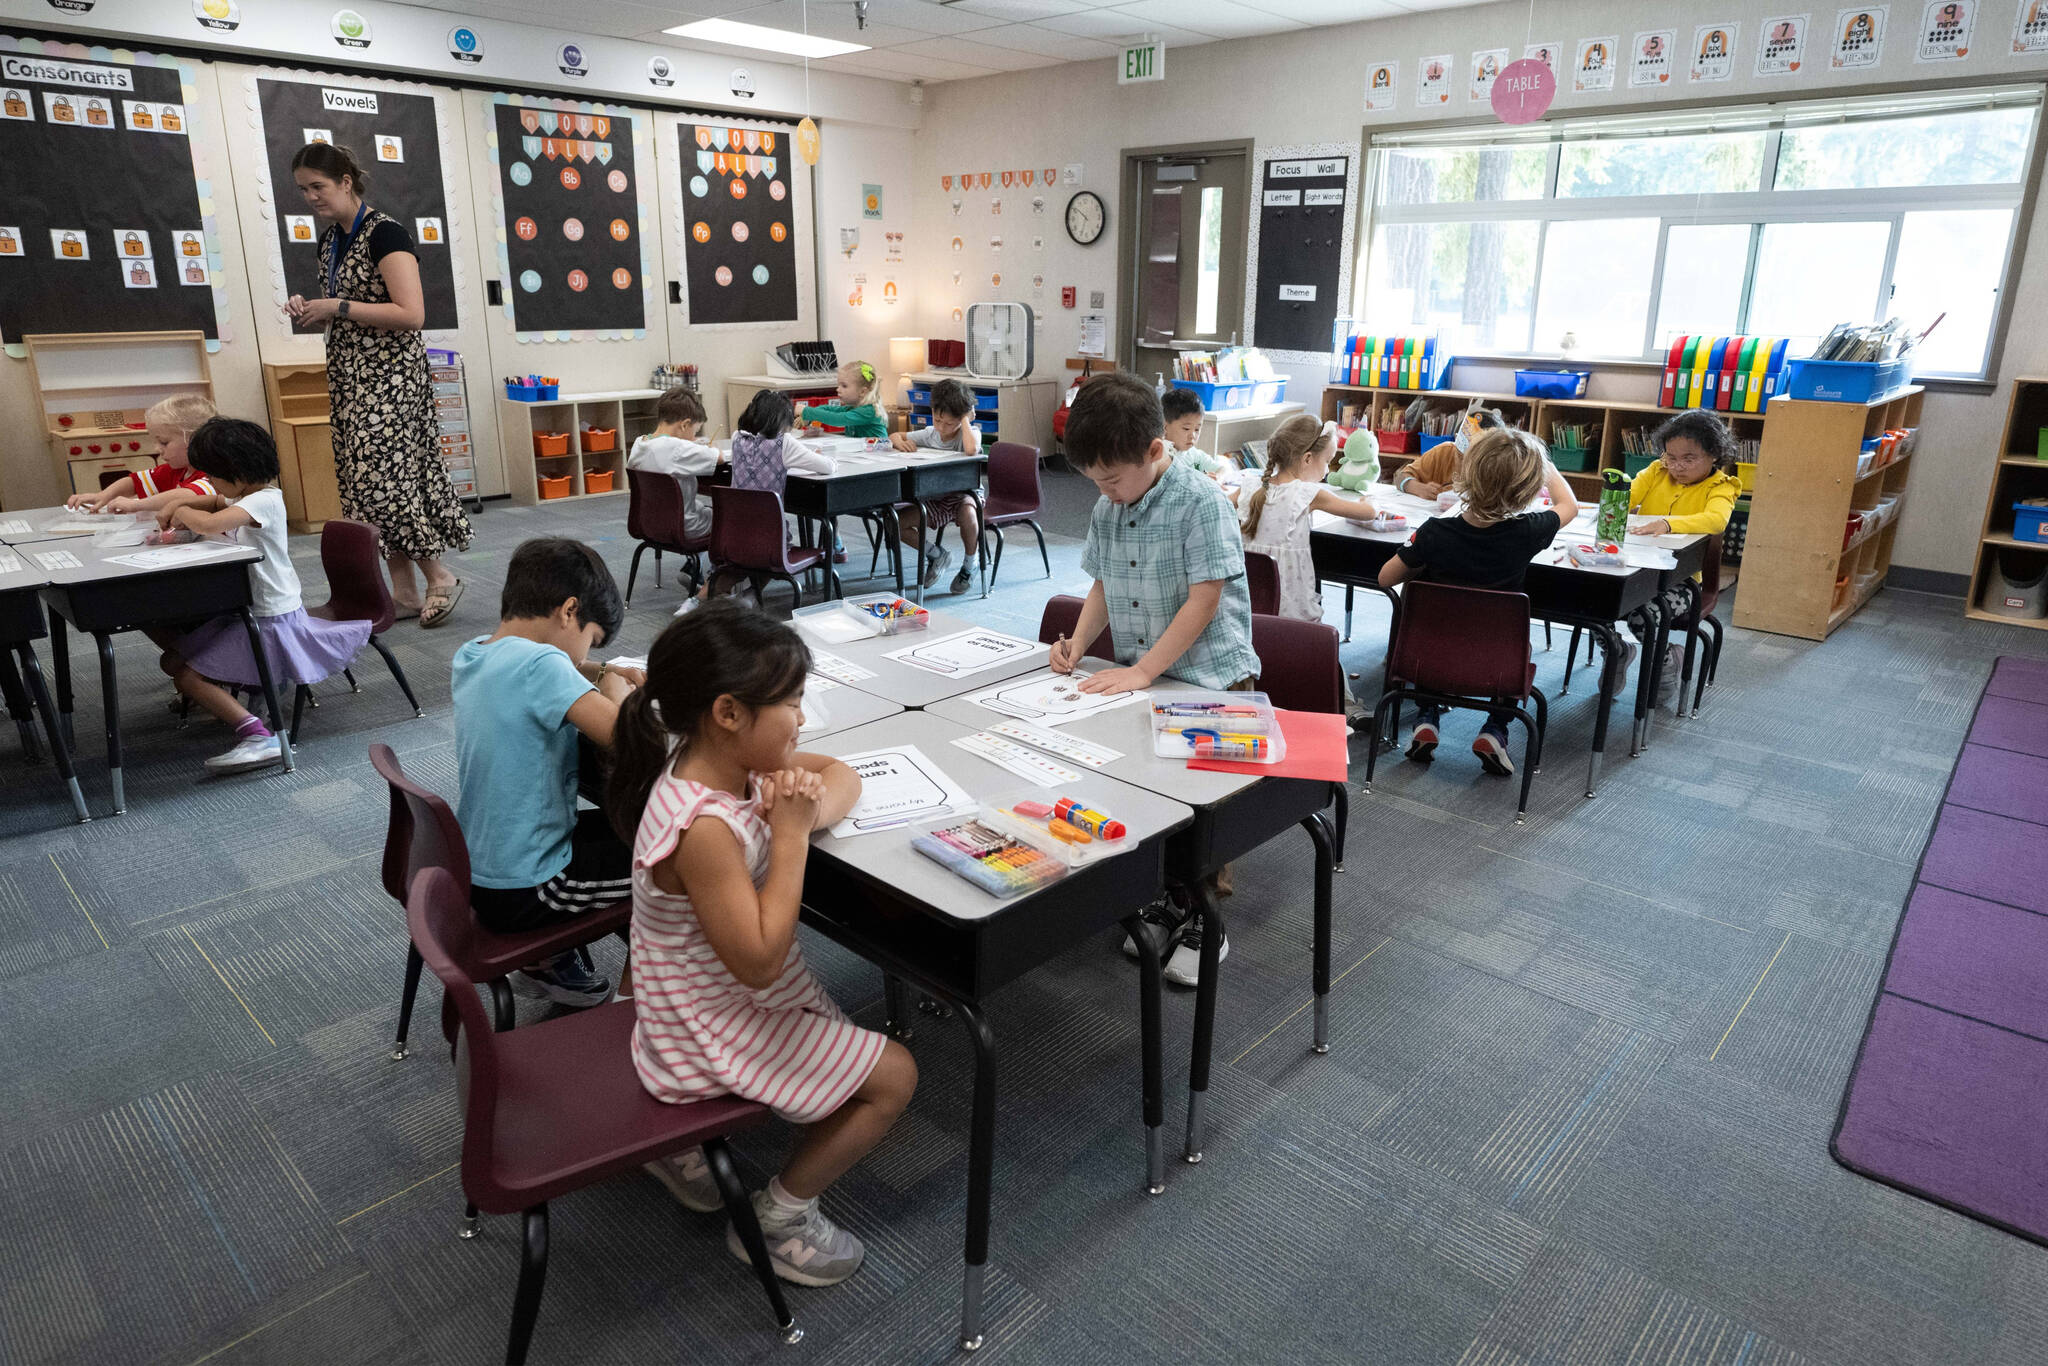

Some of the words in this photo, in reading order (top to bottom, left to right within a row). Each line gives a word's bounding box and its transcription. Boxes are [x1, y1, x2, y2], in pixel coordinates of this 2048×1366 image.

[55, 0, 87, 10] Orange
[1944, 3, 1957, 19] 9
[1858, 13, 1869, 28] 8
[2037, 9, 2048, 20] te
[207, 19, 230, 29] Yellow
[1781, 22, 1790, 37] 7
[1937, 20, 1959, 29] nine
[1711, 30, 1720, 43] 6
[1848, 27, 1872, 38] eight
[343, 38, 364, 47] Green
[1650, 36, 1660, 49] 5
[1769, 37, 1796, 46] seven
[1540, 48, 1548, 62] 3
[1593, 43, 1602, 56] 4
[460, 53, 474, 61] Blue
[1126, 46, 1156, 79] EXIT
[1486, 55, 1494, 68] 2
[1587, 56, 1605, 64] four
[6, 59, 128, 87] Consonants
[565, 67, 582, 76] Purple
[1378, 68, 1386, 80] 0
[1505, 74, 1541, 93] TABLE
[324, 92, 377, 110] Vowels
[1520, 92, 1525, 108] 1
[543, 113, 606, 135] WORD
[715, 130, 772, 150] WORD
[527, 139, 590, 159] WALL
[701, 153, 757, 173] WALL
[1275, 165, 1301, 175] Focus
[1317, 163, 1336, 174] Wall
[563, 172, 578, 184] Bb
[732, 183, 745, 195] Nn
[1270, 193, 1293, 202] Letter
[1305, 193, 1321, 203] Sight
[1322, 193, 1343, 201] Words
[519, 222, 533, 235] Ff
[566, 223, 581, 237] Gg
[612, 224, 627, 236] Hh
[695, 225, 708, 240] Pp
[774, 226, 784, 238] Tt
[572, 274, 584, 289] Jj
[1286, 288, 1310, 297] Theme
[976, 636, 1017, 649] special
[851, 760, 889, 771] spec
[860, 770, 887, 779] am
[775, 1238, 818, 1268] N
